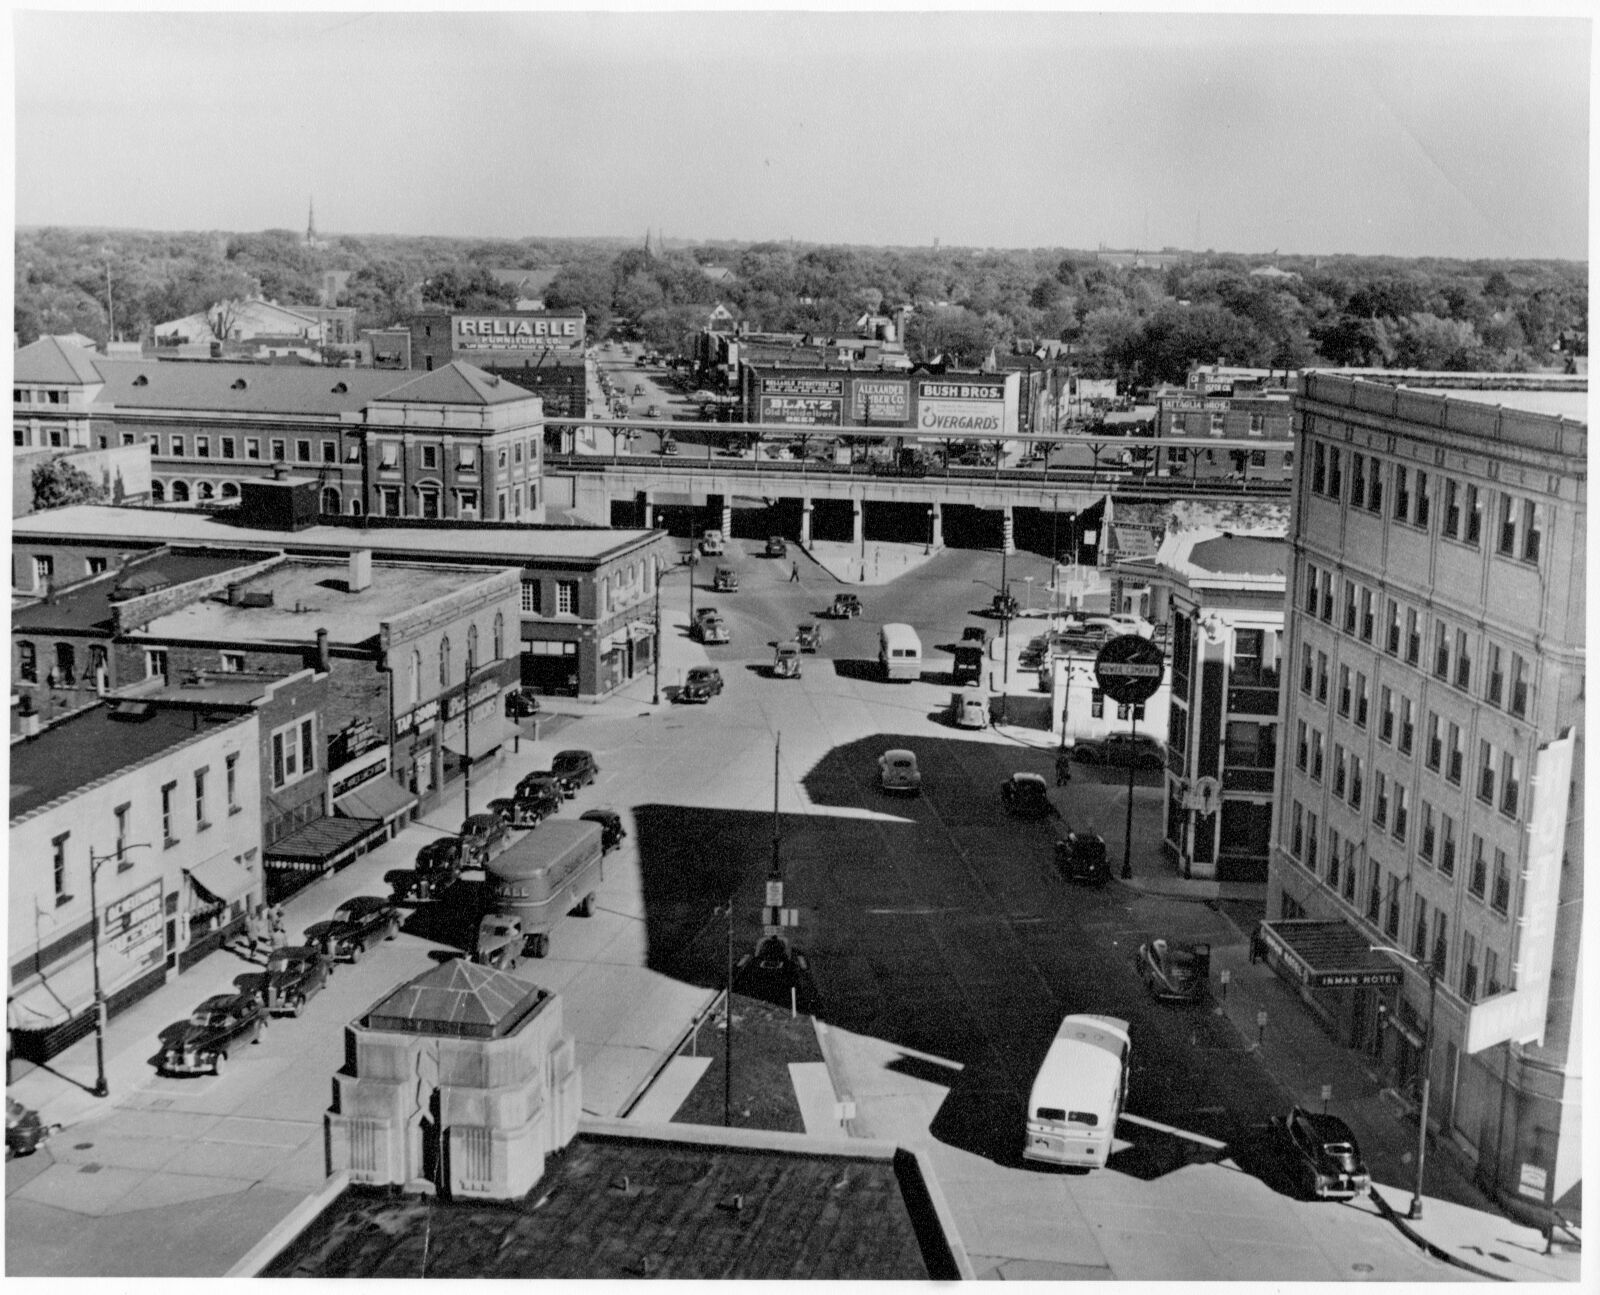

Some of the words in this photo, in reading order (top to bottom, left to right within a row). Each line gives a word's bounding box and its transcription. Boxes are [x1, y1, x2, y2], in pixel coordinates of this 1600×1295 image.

[460, 320, 577, 336] RELIABLE
[482, 336, 543, 345] FURNITURE
[859, 383, 904, 395] ALEXANDER
[923, 385, 959, 397] BUSH
[961, 387, 1001, 398] BROS.
[770, 399, 833, 410] BLATZ
[764, 407, 781, 416] Old
[922, 412, 1000, 430] OVERGARD'S
[395, 712, 413, 735] TAP
[1322, 975, 1358, 985] INMAN
[1363, 975, 1398, 984] HOTEL
